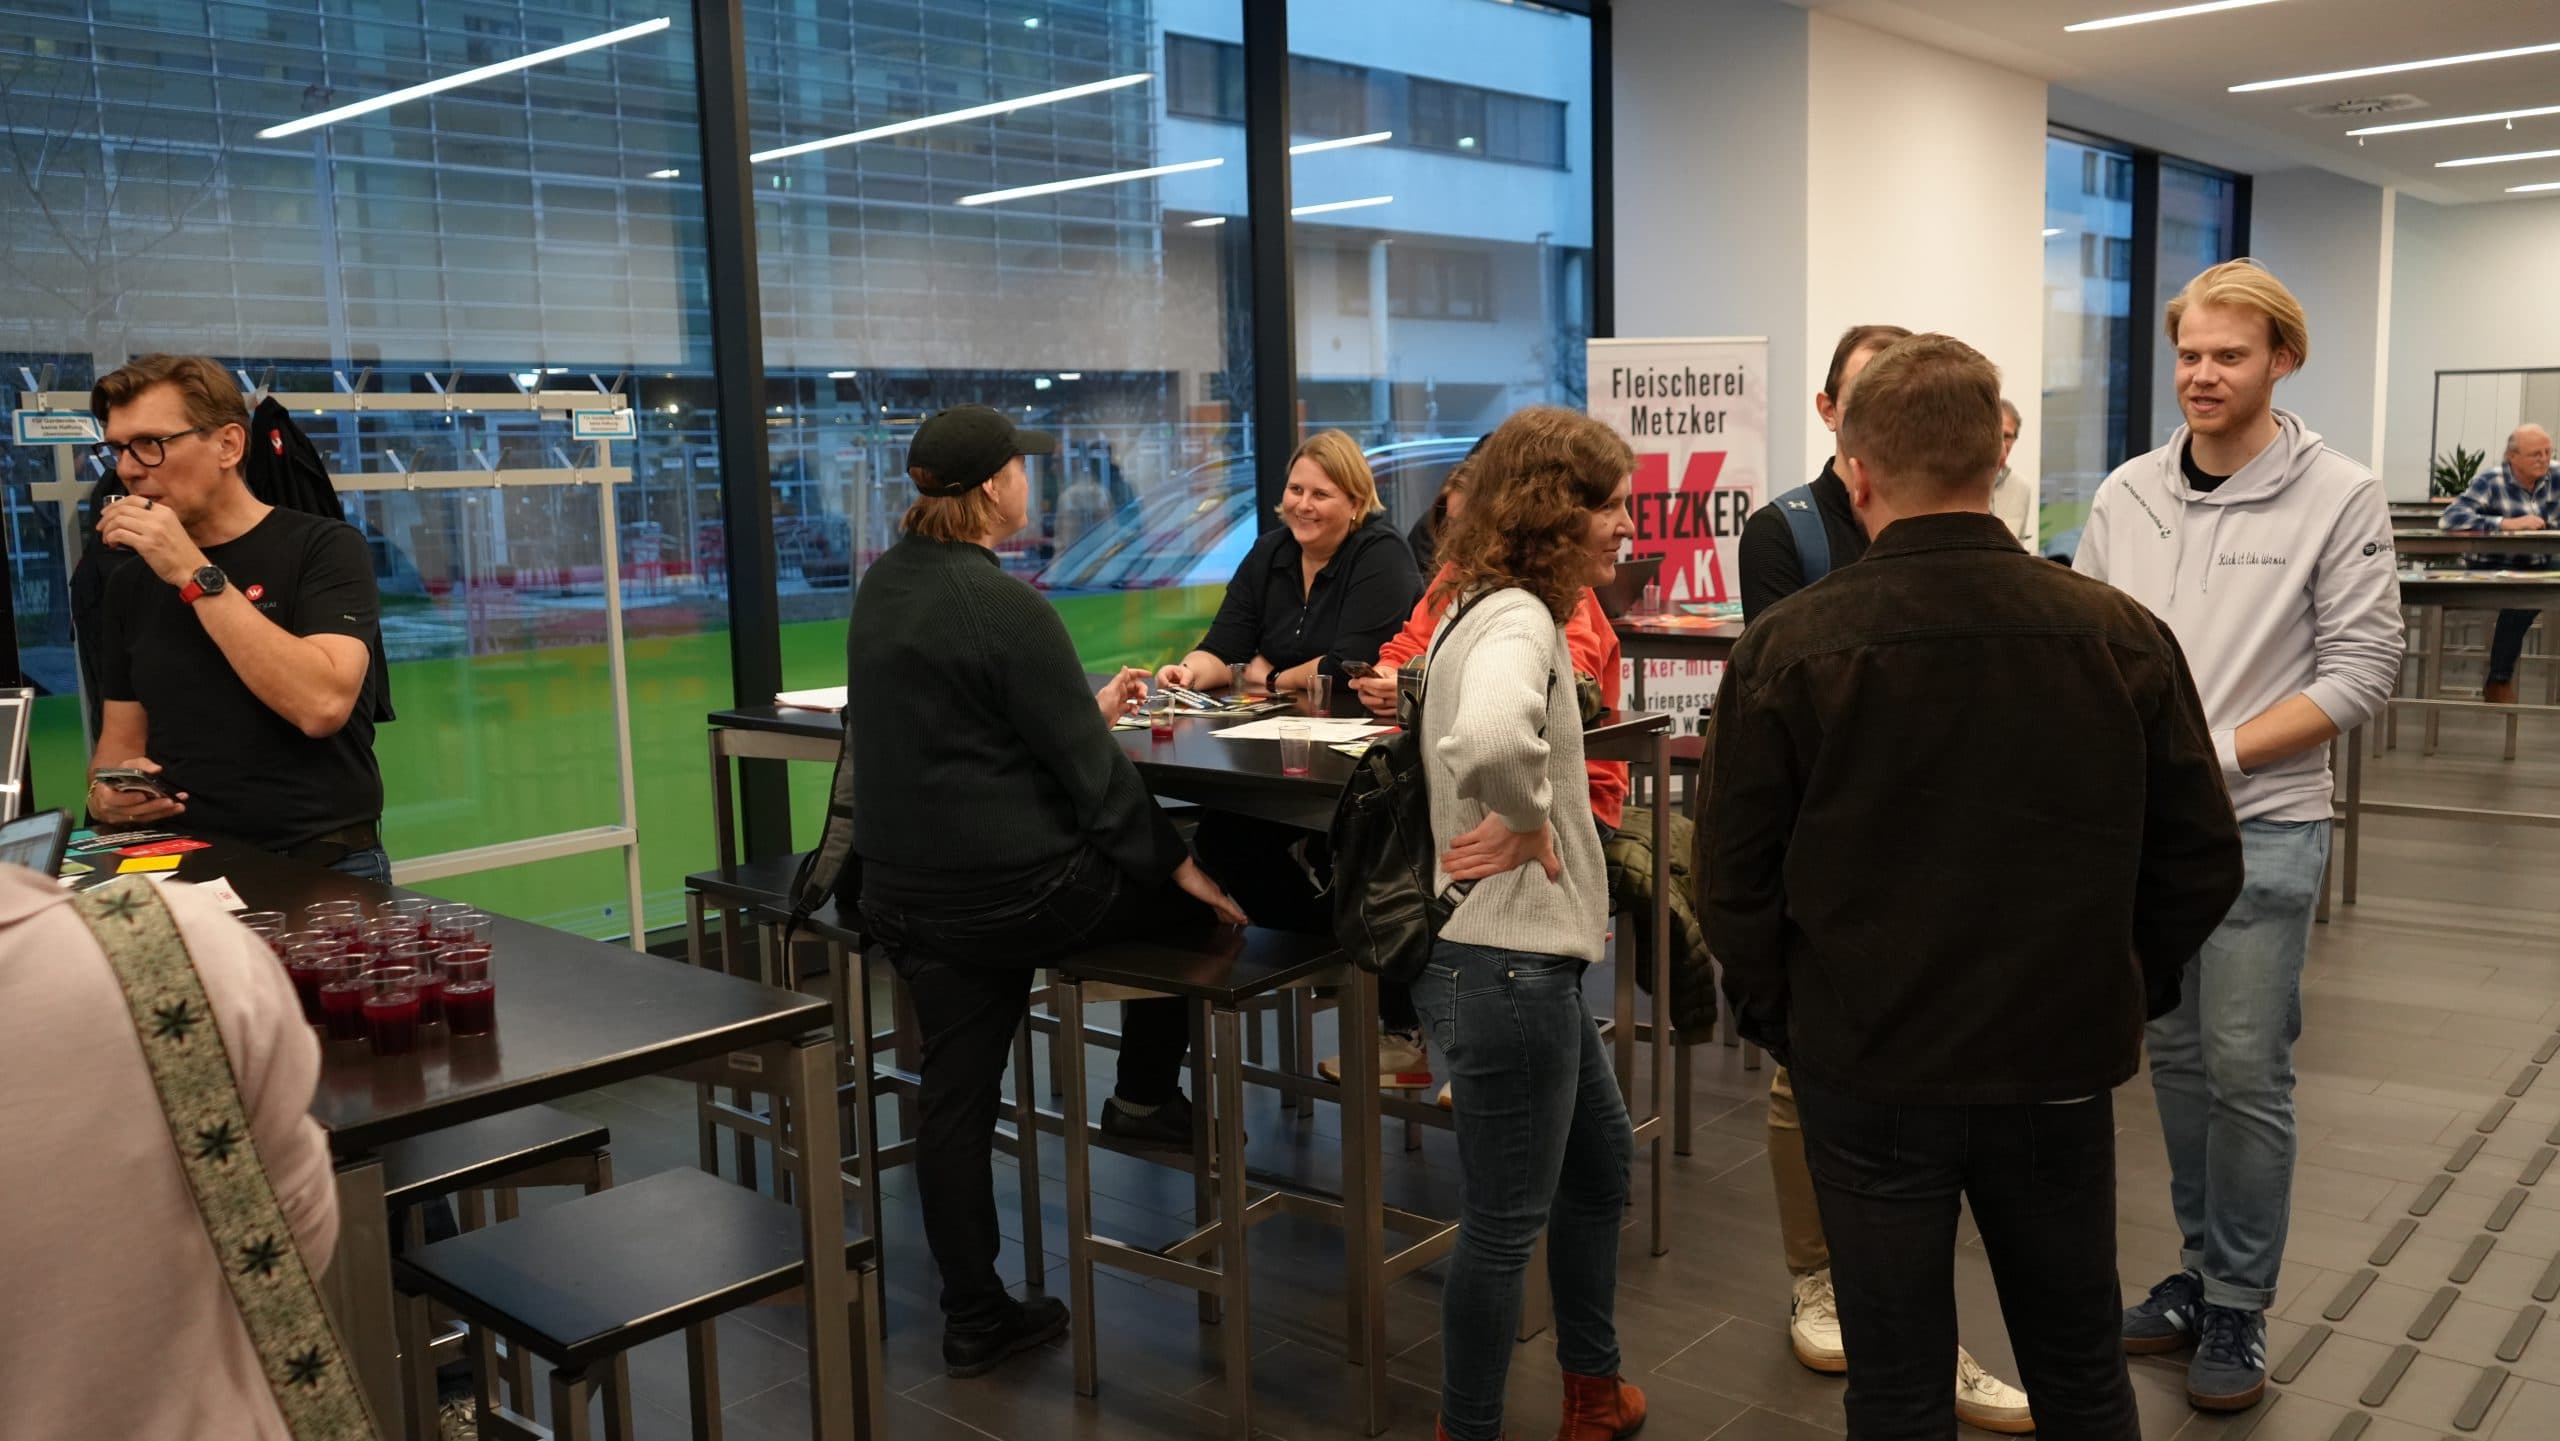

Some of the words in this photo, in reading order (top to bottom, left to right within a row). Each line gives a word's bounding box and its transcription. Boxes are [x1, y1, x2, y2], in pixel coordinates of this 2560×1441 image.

[1612, 365, 1744, 399] Fleischerei
[1631, 403, 1727, 436] Metzker
[1693, 549, 1716, 599] K
